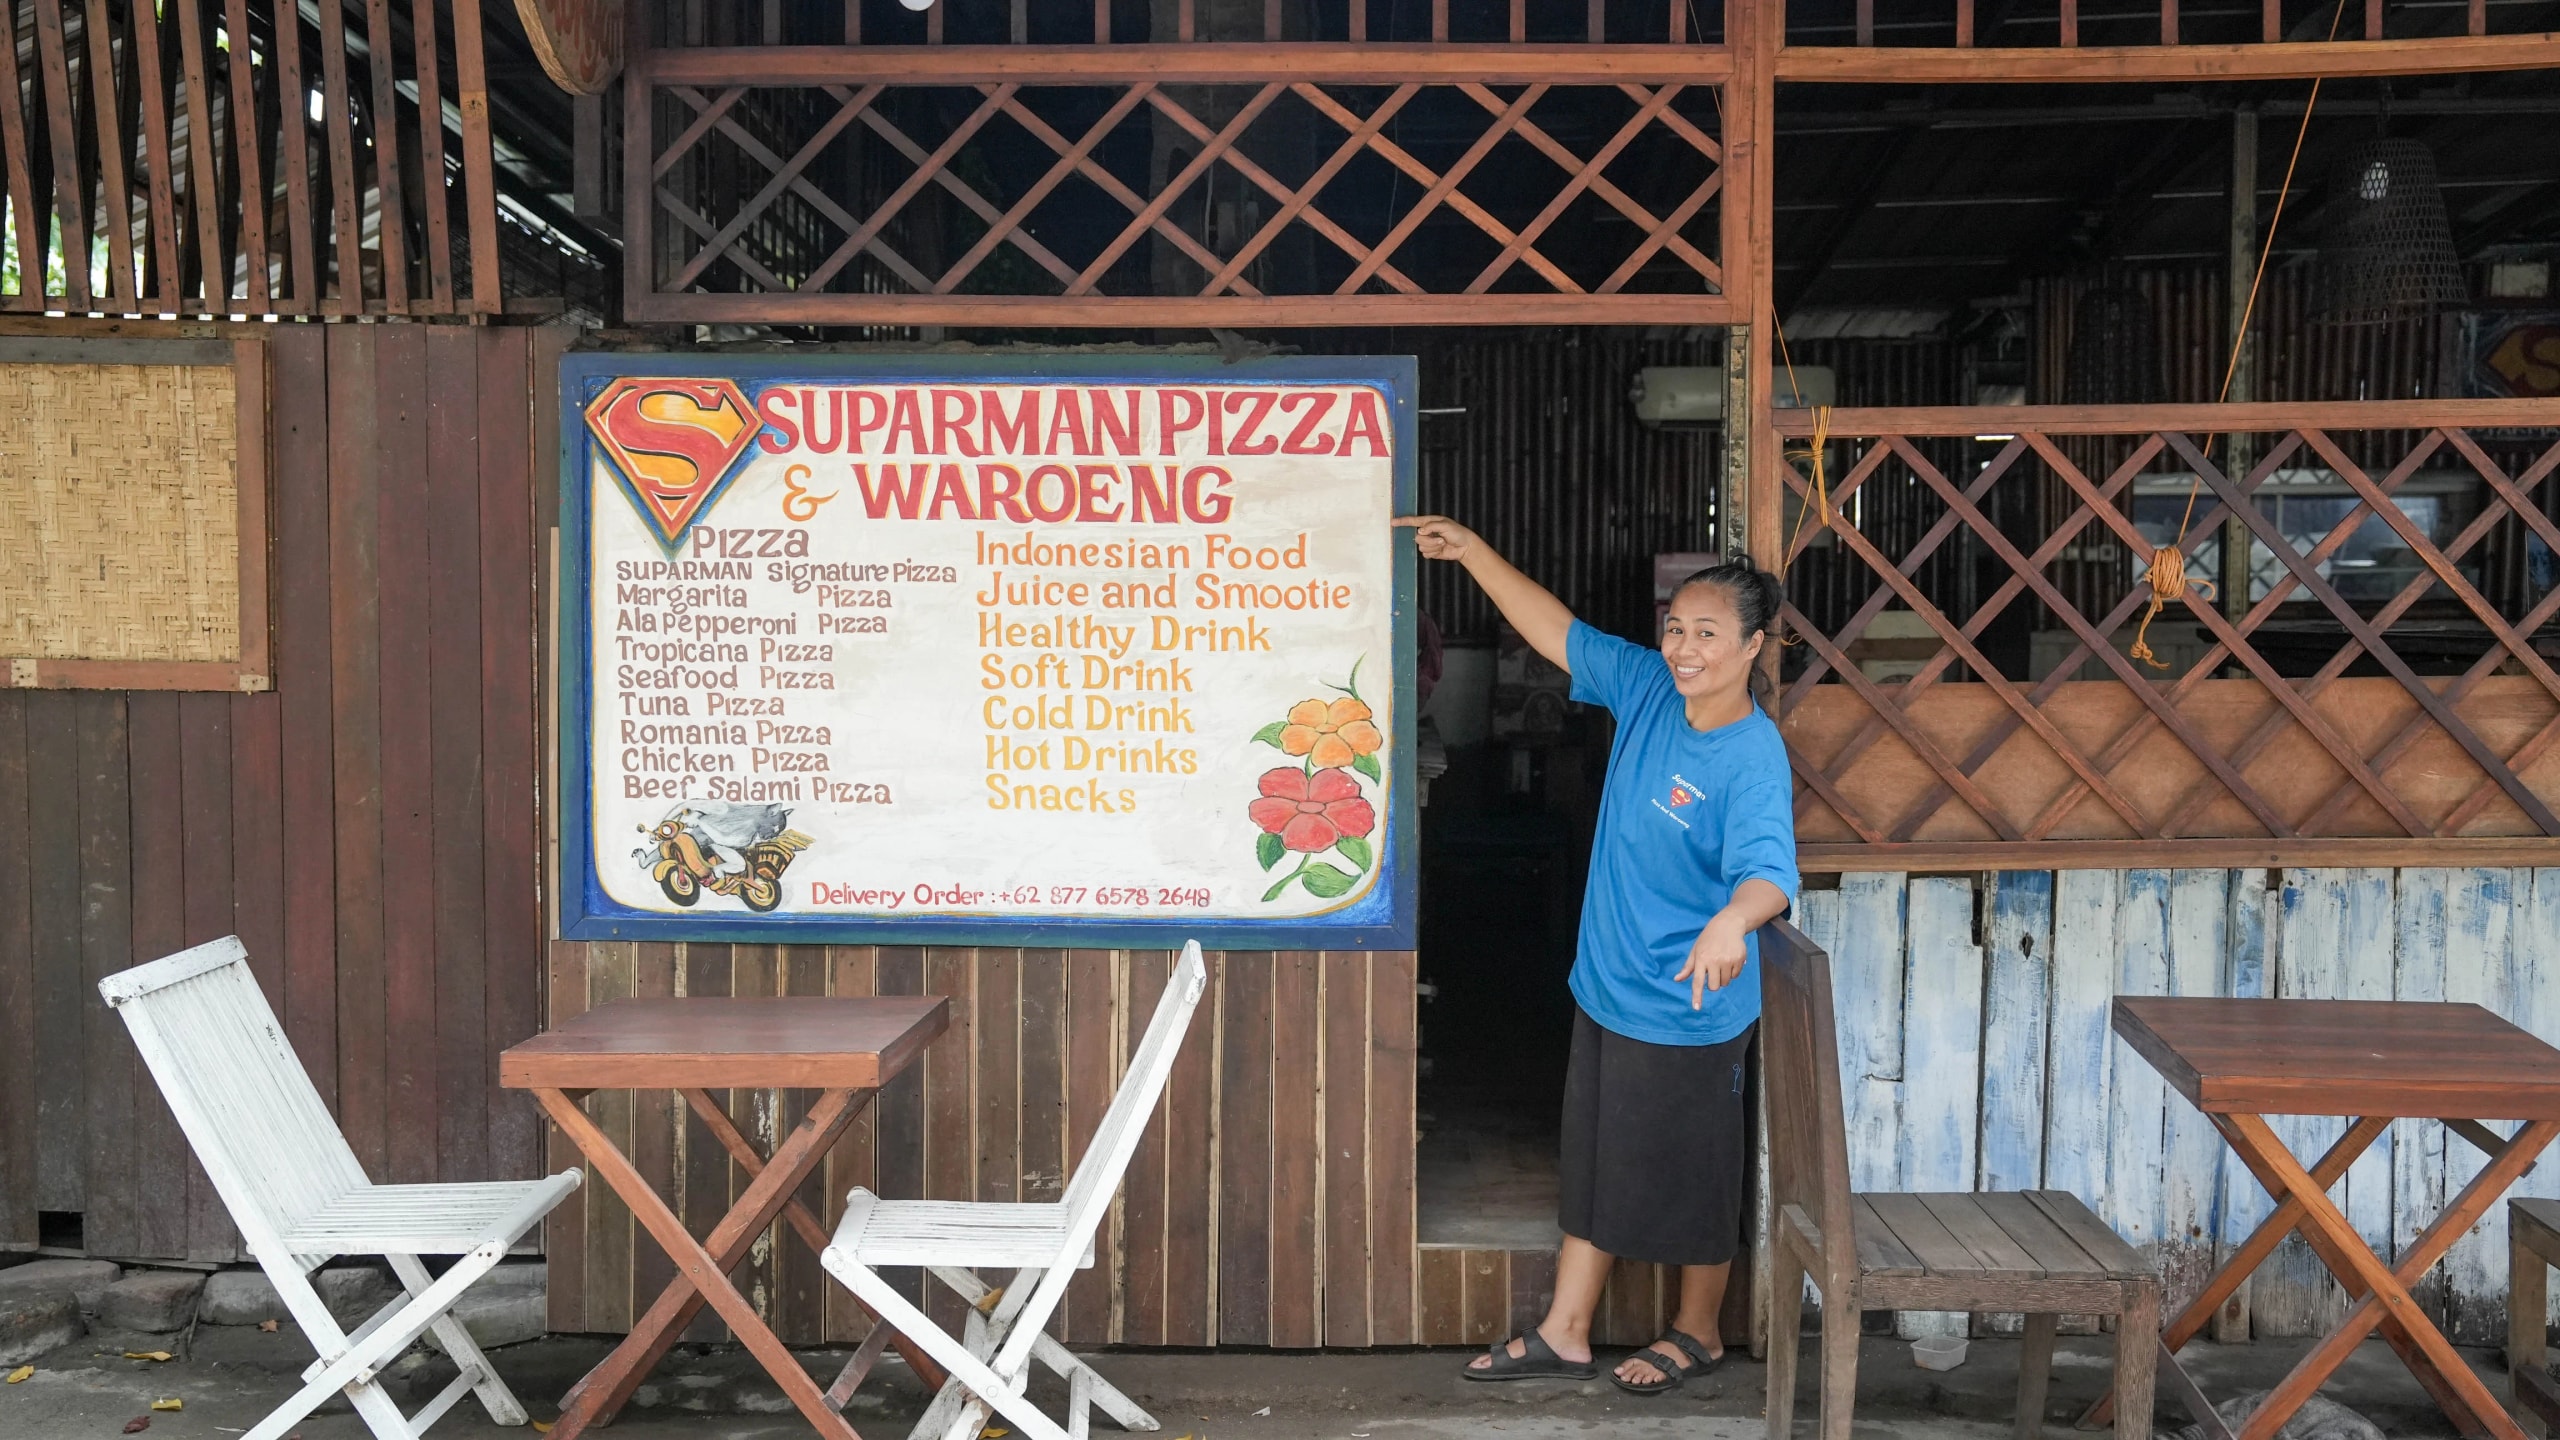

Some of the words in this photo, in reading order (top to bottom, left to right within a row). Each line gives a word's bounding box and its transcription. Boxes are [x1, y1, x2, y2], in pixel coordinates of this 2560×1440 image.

[757, 388, 1146, 457] SUPARMAN
[1156, 390, 1391, 458] PIZZA
[782, 463, 840, 522] &
[850, 463, 1234, 524] WAROENG
[690, 525, 809, 558] Pizza
[976, 531, 1189, 569] Indonesian
[1205, 533, 1307, 570] Food
[616, 560, 752, 580] SUPARMAN
[767, 560, 889, 594] Signature
[893, 558, 956, 583] Pizza
[977, 571, 1088, 606] Juice
[1102, 573, 1176, 608] and
[1196, 573, 1351, 610] Smootie
[617, 583, 747, 615] Margarita
[817, 585, 891, 608] Pizza
[818, 613, 887, 634] Pizza
[979, 612, 1135, 660] Healthy
[1151, 615, 1272, 651] Drink
[616, 635, 748, 668] Tropicana
[760, 638, 833, 662] Pizza
[618, 664, 738, 689] Seafood
[760, 666, 834, 689] Pizza
[981, 653, 1071, 690] Soft
[1081, 654, 1193, 692] Drink
[619, 692, 690, 716] Tuna
[707, 693, 784, 716] Pizza
[983, 694, 1074, 730] Cold
[1085, 695, 1195, 733] Drink
[621, 720, 747, 745] Romania
[756, 720, 831, 745] Pizza
[622, 747, 734, 773] Chicken
[752, 747, 829, 773] Pizza
[986, 735, 1050, 770] Hot
[1063, 736, 1197, 774] Drinks
[624, 775, 697, 800] Beef
[708, 776, 800, 802] Salami
[812, 777, 892, 804] Pizza
[986, 773, 1136, 813] Snacks
[812, 882, 905, 909] Delivery
[1051, 887, 1087, 904] 877
[1096, 887, 1149, 906] 6578
[1159, 887, 1210, 907] 2648
